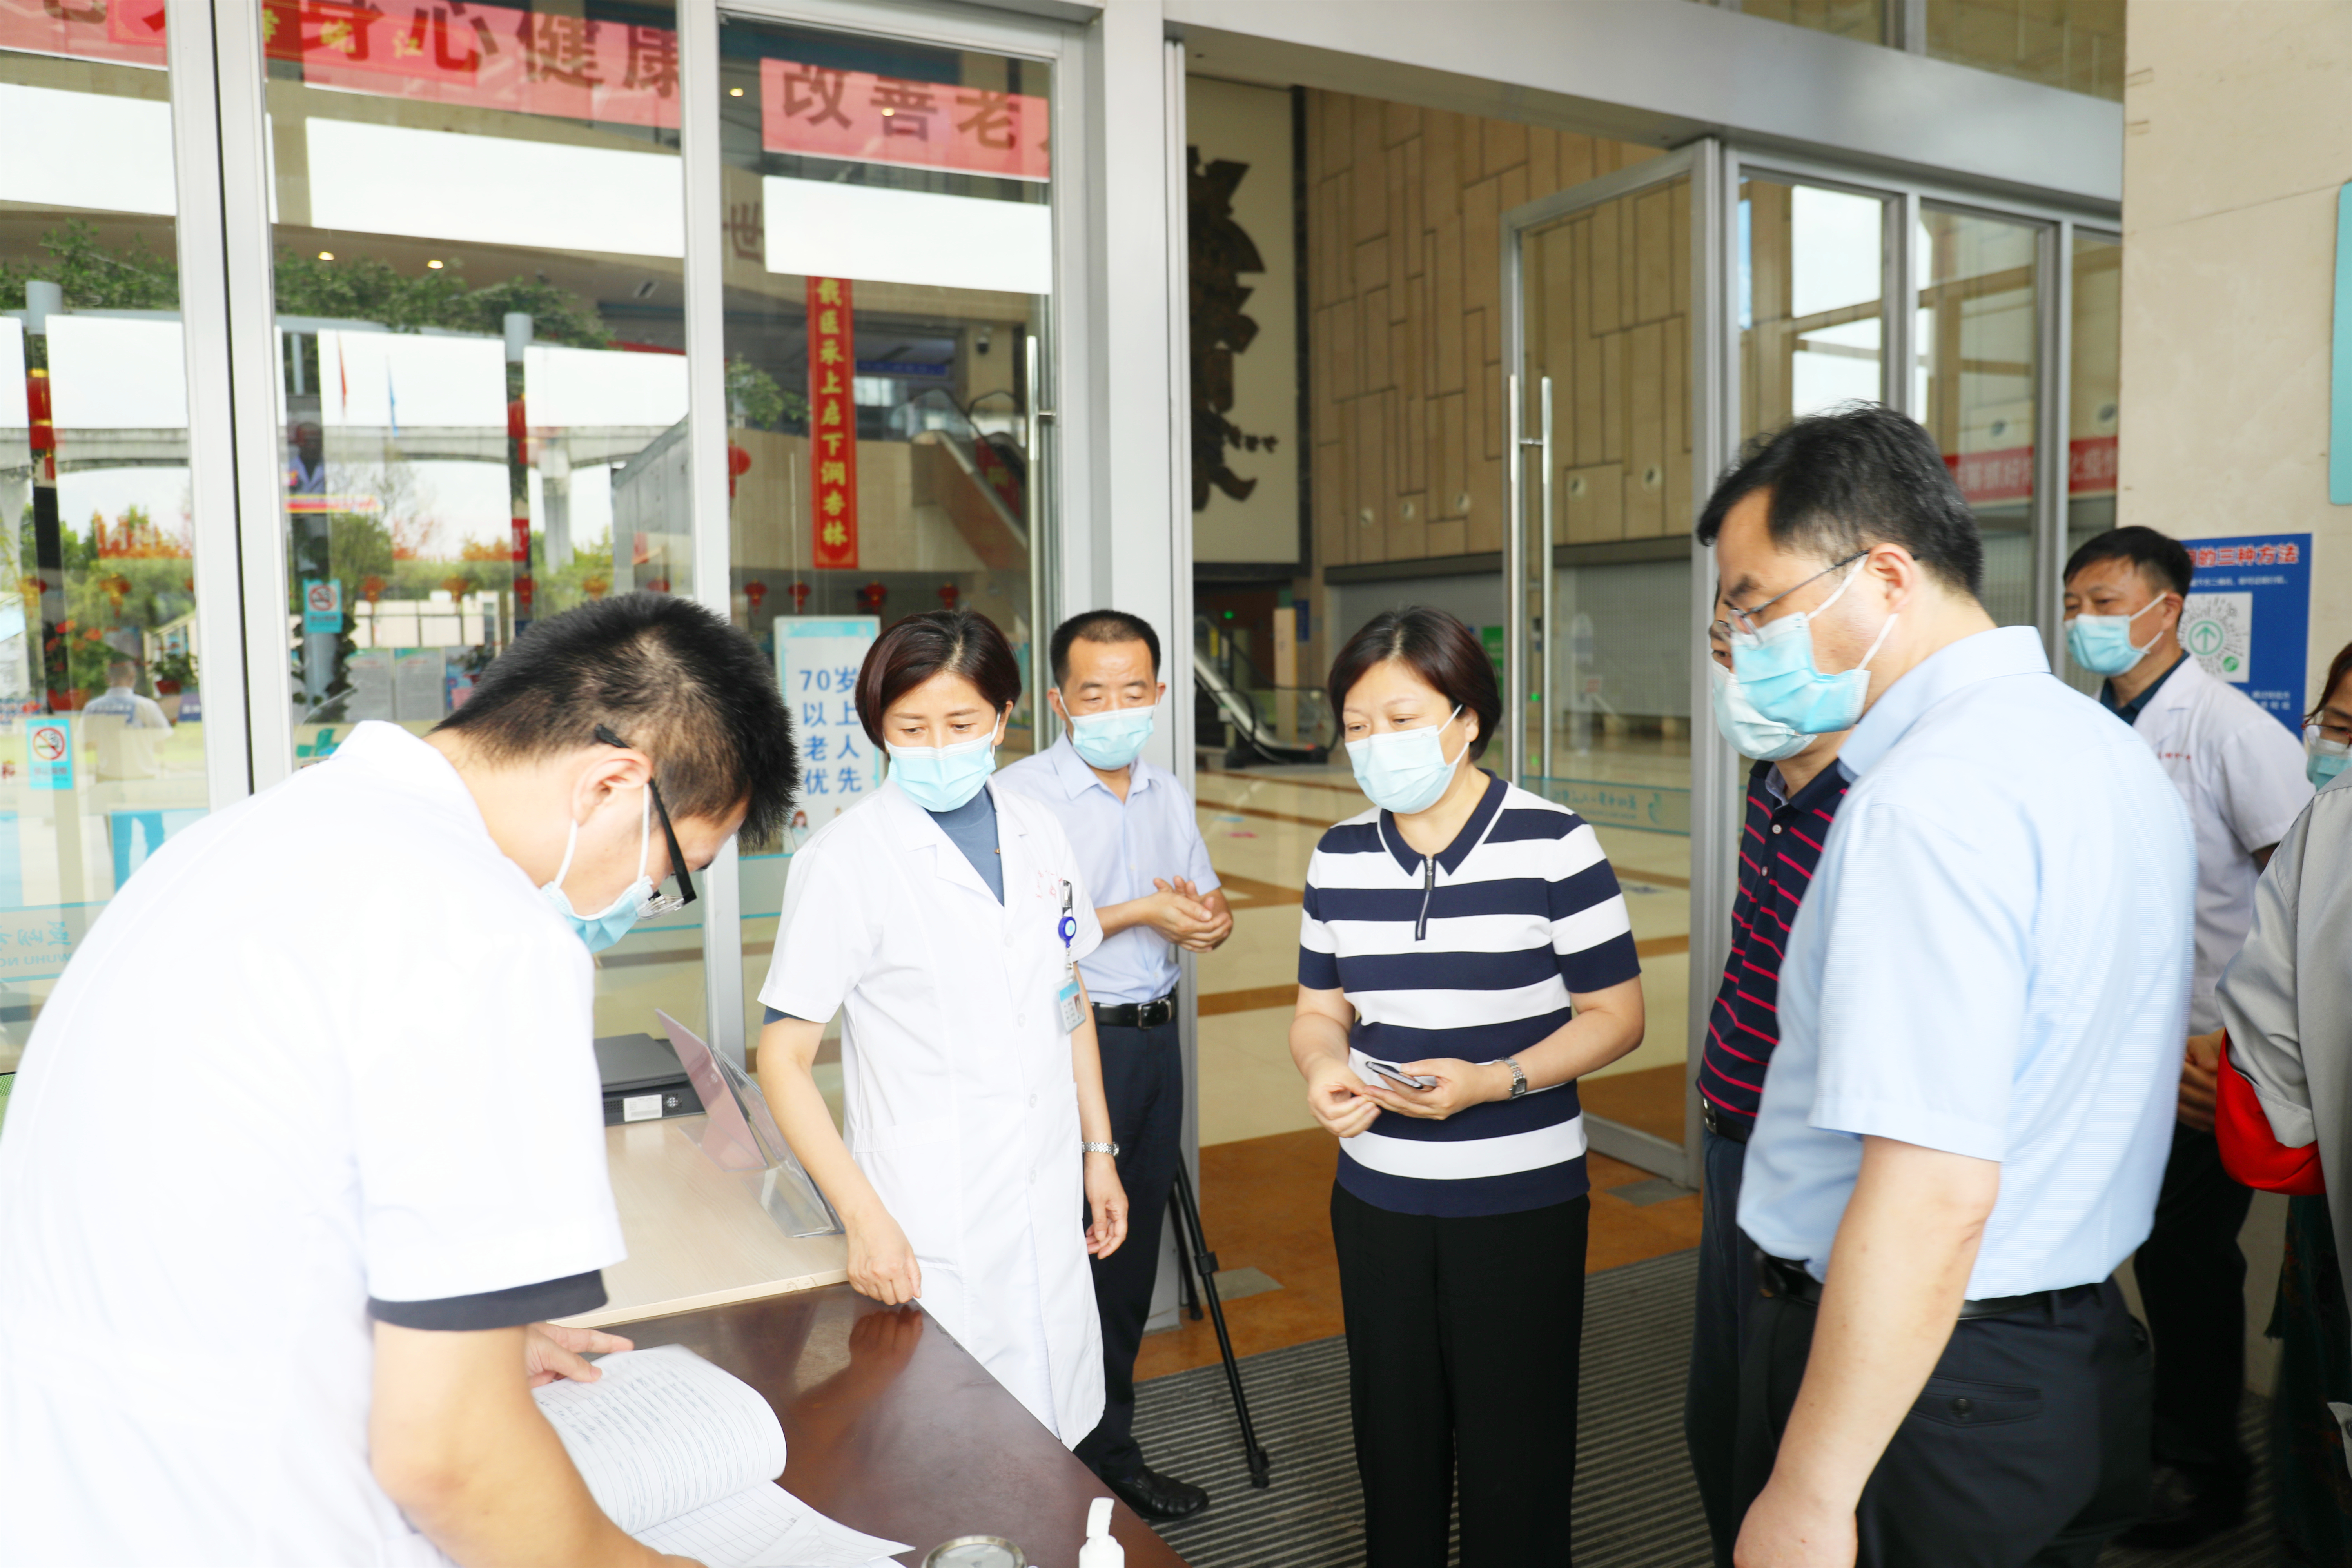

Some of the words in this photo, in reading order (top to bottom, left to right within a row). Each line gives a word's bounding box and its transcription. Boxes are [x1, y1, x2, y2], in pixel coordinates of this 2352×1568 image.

[782, 65, 1049, 153] 改善老
[799, 666, 858, 693] 70岁
[803, 701, 861, 727] 以上
[804, 734, 860, 762] 老人
[804, 768, 862, 795] 优先
